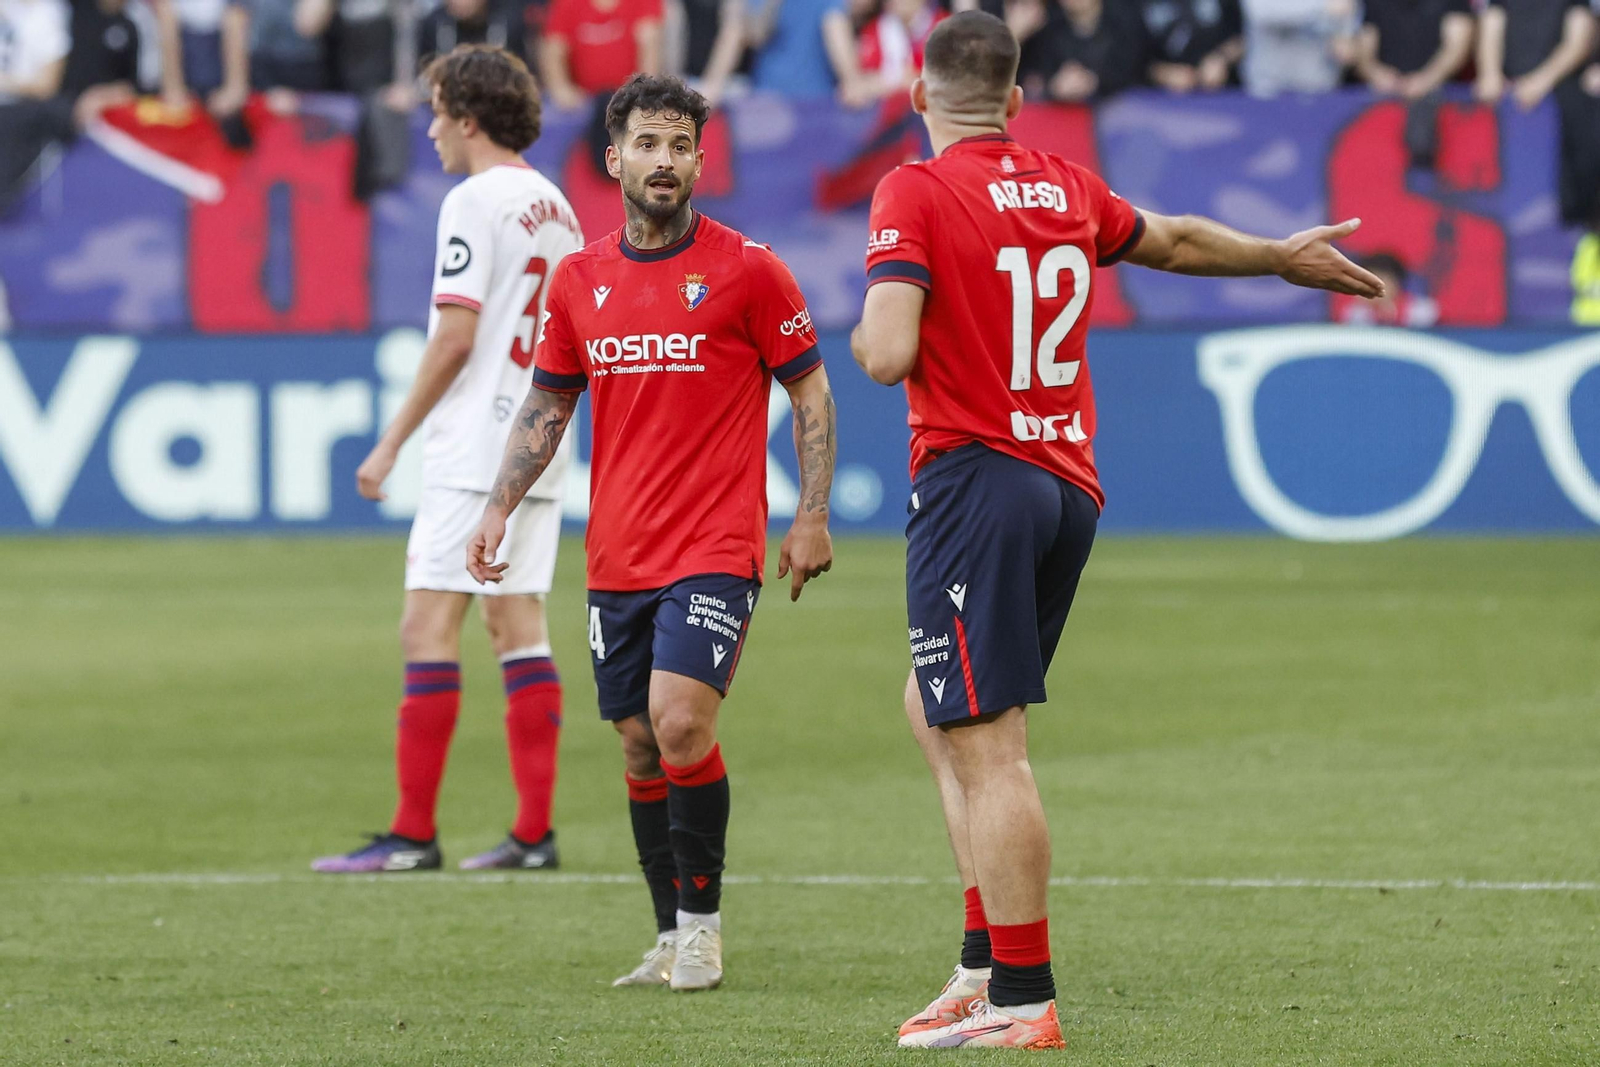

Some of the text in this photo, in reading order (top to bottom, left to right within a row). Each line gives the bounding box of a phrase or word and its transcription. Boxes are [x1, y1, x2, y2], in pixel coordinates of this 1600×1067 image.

[987, 180, 1068, 213] ARESO
[995, 244, 1091, 391] 12
[665, 363, 706, 373] eficiente
[690, 593, 727, 610] Clínica
[686, 614, 738, 642] de Navarra
[689, 603, 742, 631] Universidad
[914, 651, 949, 668] Navarra
